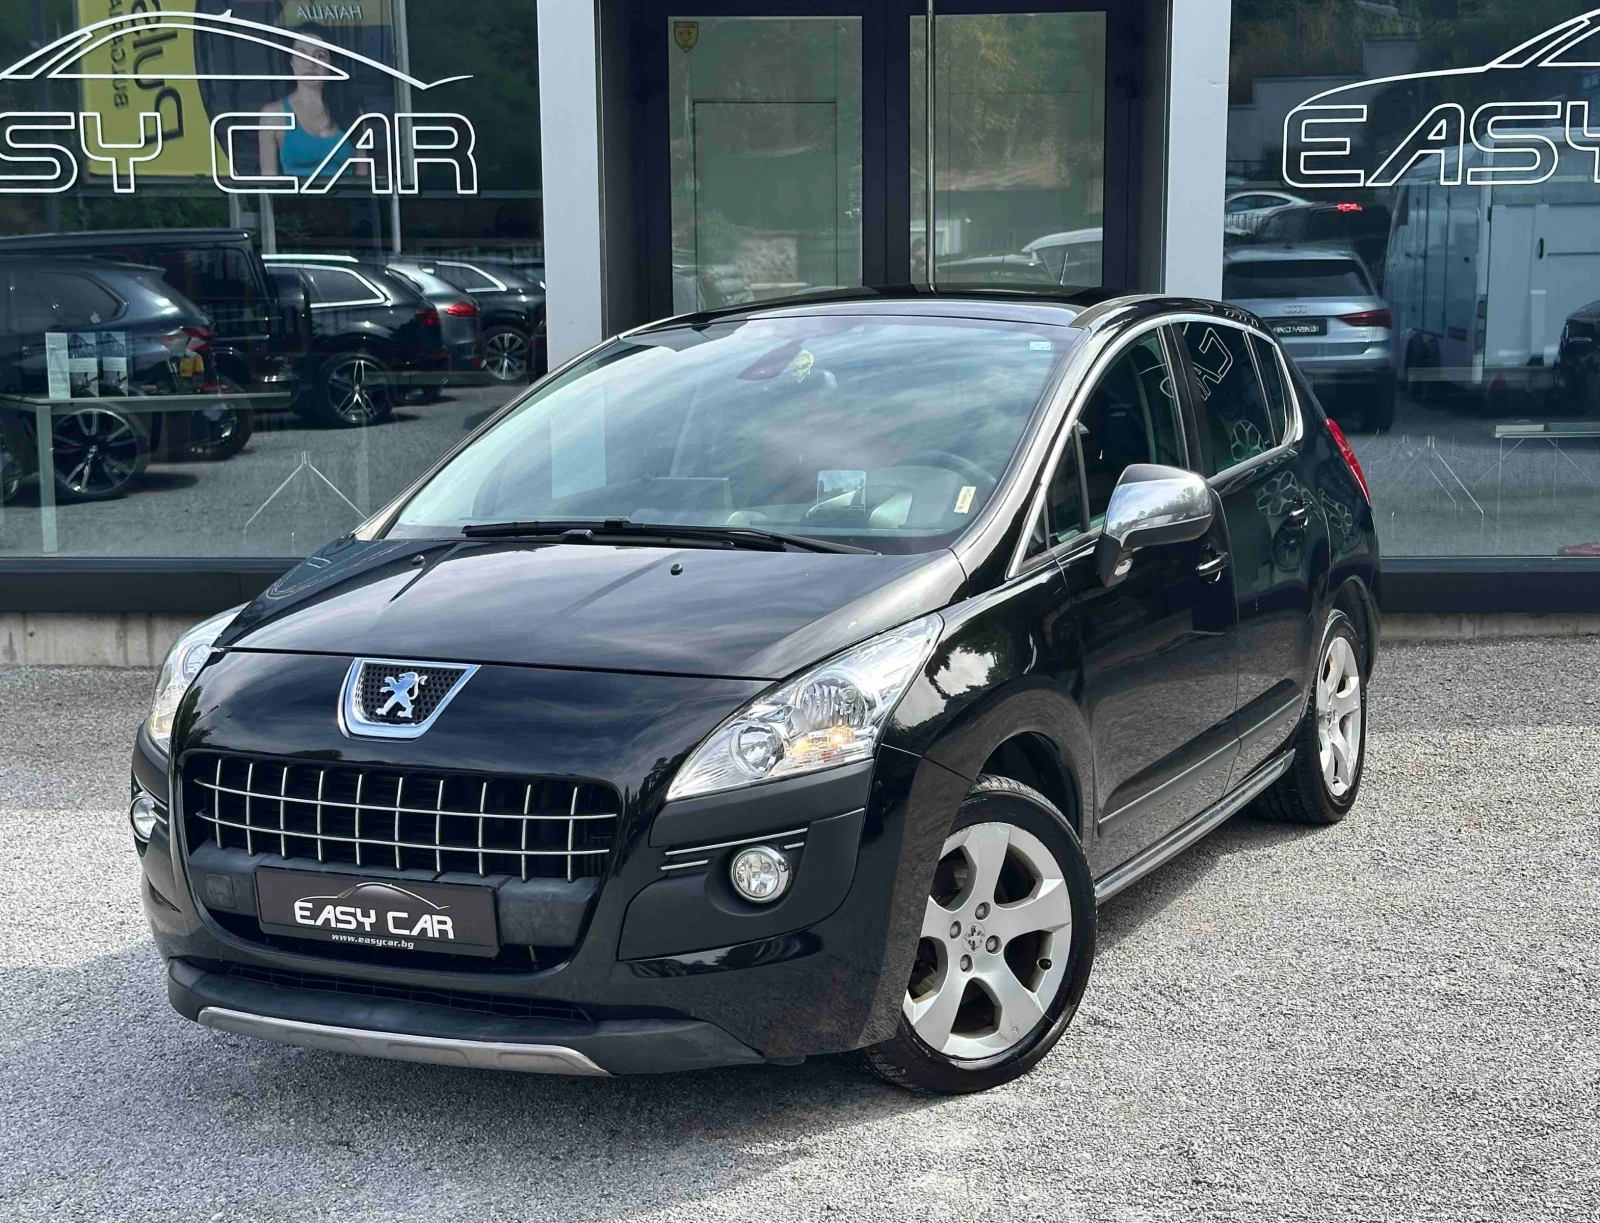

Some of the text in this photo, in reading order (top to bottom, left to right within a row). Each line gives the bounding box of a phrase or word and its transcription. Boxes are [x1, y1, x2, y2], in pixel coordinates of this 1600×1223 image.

[210, 113, 478, 195] CAR
[294, 901, 455, 940] EASY CAR
[331, 933, 415, 950] www.easycar.bg
